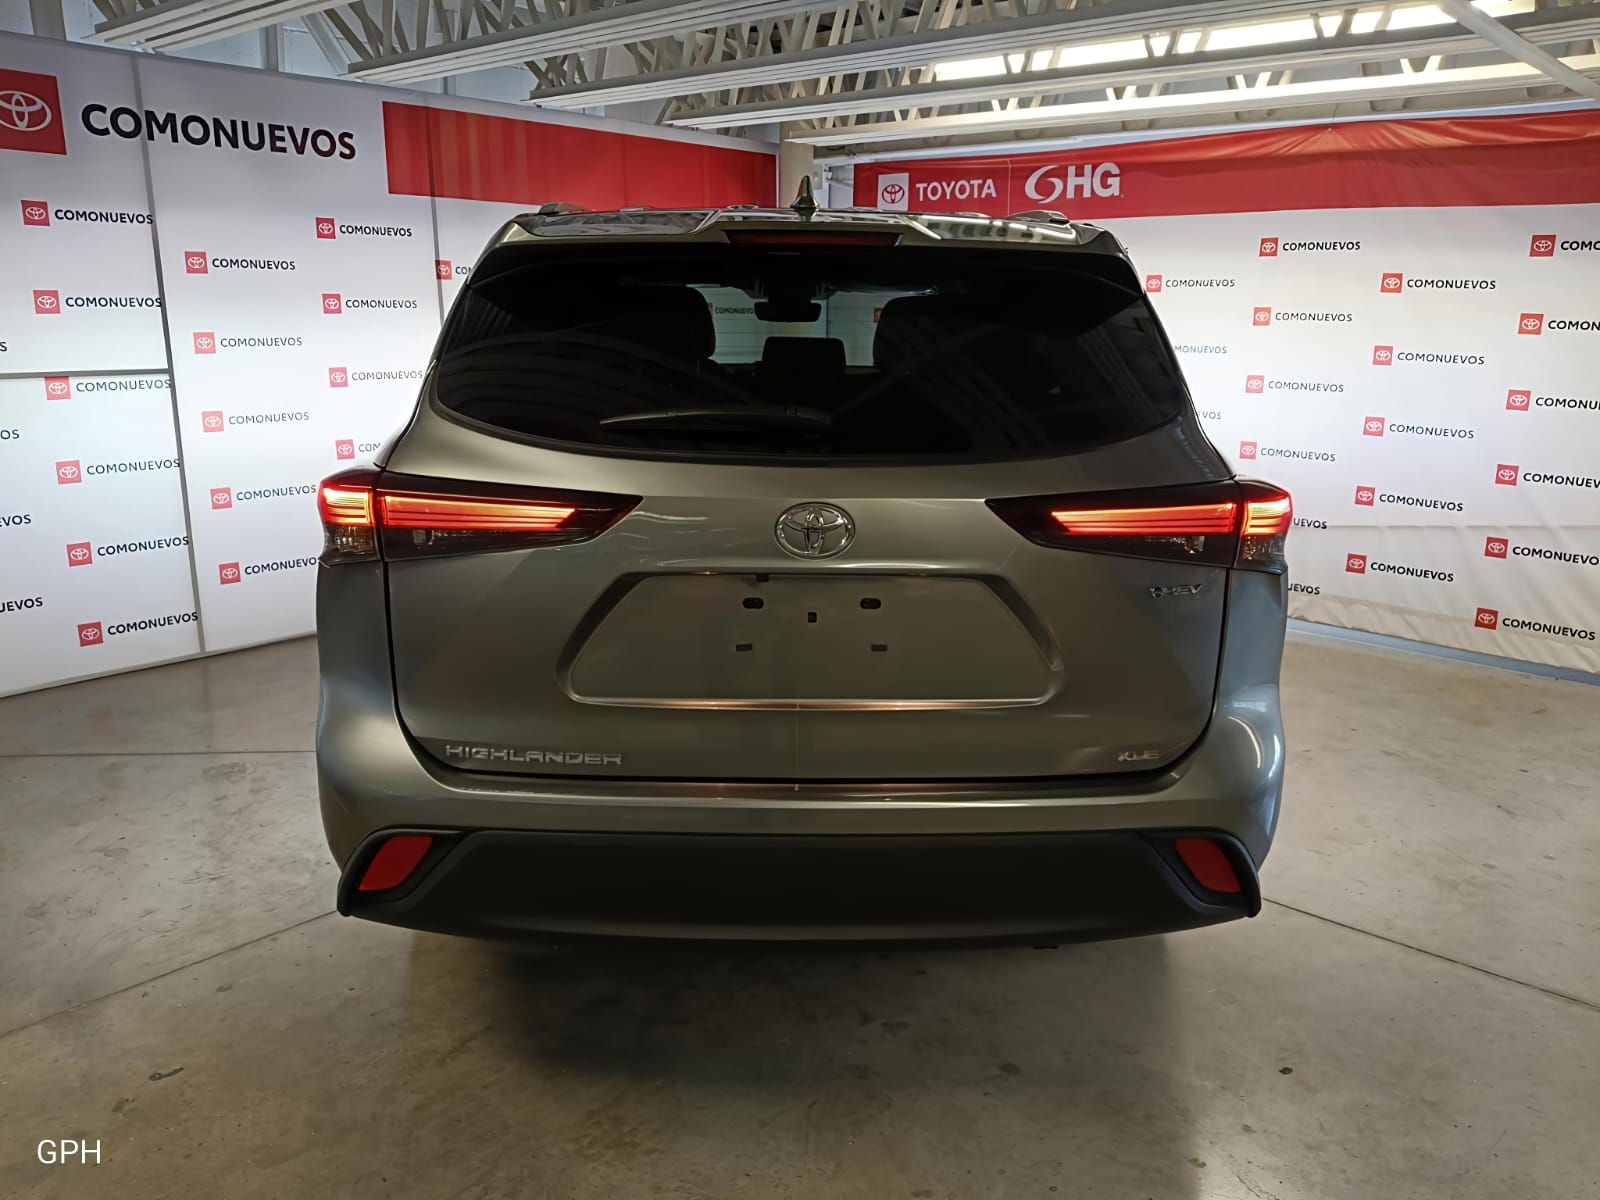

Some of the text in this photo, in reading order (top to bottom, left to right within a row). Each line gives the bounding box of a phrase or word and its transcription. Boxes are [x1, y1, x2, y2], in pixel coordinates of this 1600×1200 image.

[81, 101, 357, 160] COMONUEVOS
[915, 178, 997, 202] TOYOTA
[54, 209, 154, 225] COMONUEVOS
[339, 224, 413, 238] COMONUEVOS
[1282, 241, 1361, 252] COMONUEVOS
[211, 258, 296, 271] COMONUEVOS
[1165, 278, 1236, 288] COMONUEVOS
[1406, 279, 1497, 291] COMONUEVOS
[65, 297, 162, 308] COMONUEVOS
[345, 299, 418, 310] COMONUEVOS
[1275, 312, 1354, 323] COMONUEVOS
[220, 336, 303, 348] COMONUEVOS
[1397, 352, 1486, 366] COMONUEVOS
[351, 370, 424, 381] COMONUEVOS
[75, 379, 172, 393] COMONUEVOS
[1268, 380, 1345, 393] COMONUEVOS
[228, 411, 310, 425] COMONUEVOS
[1389, 423, 1475, 440] COMONUEVOS
[1260, 447, 1337, 463] COMONUEVOS
[86, 458, 181, 476] COMONUEVOS
[236, 484, 317, 501] COMONUEVOS
[1379, 493, 1464, 513] COMONUEVOS
[97, 535, 190, 557] COMONUEVOS
[1370, 561, 1454, 583] COMONUEVOS
[107, 612, 199, 636] COMONUEVOS
[1502, 617, 1597, 641] COMONUEVOS
[445, 745, 622, 765] HIGHLANDER
